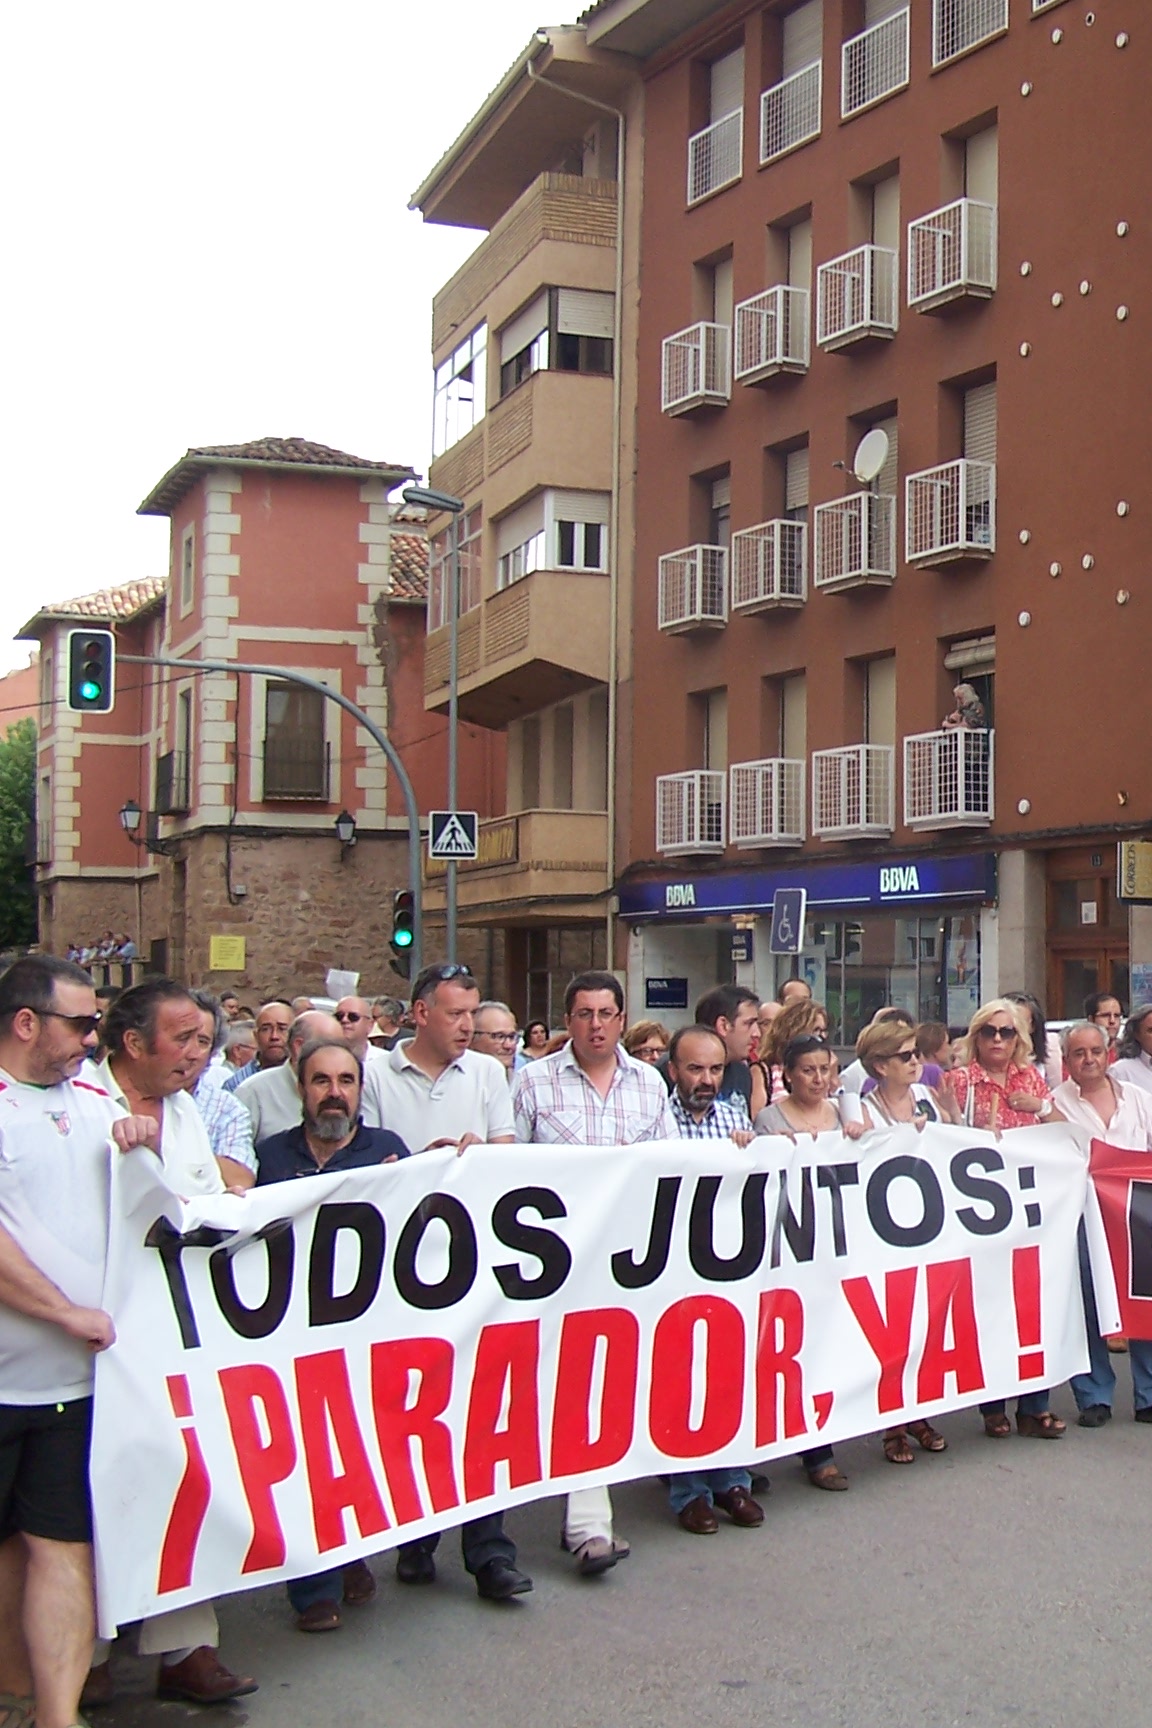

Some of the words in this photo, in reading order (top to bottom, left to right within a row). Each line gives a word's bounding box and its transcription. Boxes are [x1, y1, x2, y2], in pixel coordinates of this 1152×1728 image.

[666, 884, 695, 906] BBVA
[879, 866, 919, 892] BBVA
[144, 1186, 572, 1349] TODOS
[611, 1147, 1043, 1289] JUNTOS:
[157, 1287, 833, 1595] ¡PARADOR,
